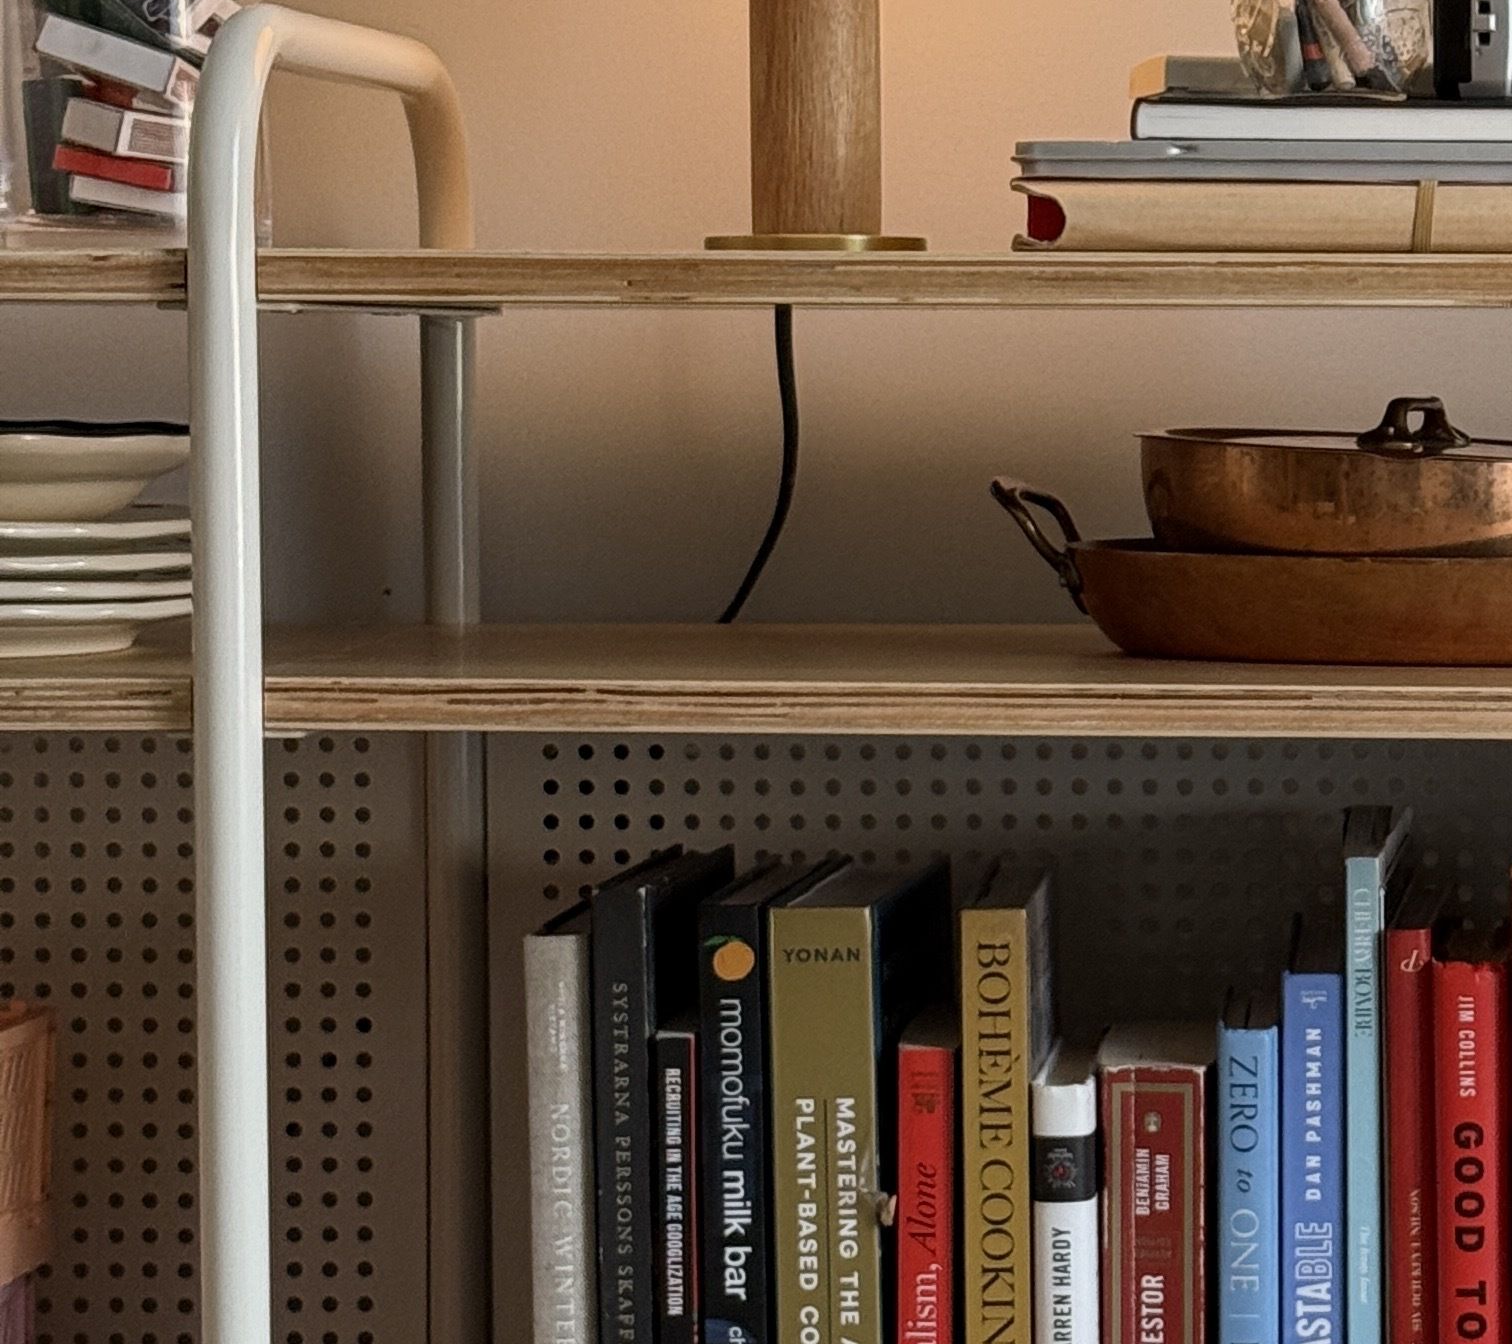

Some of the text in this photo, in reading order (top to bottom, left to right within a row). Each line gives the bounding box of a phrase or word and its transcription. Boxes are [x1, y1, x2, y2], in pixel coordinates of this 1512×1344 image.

[782, 948, 860, 963] YONAN
[1354, 968, 1374, 1037] BOMBE
[612, 983, 629, 1124] SYSTRARNA
[1305, 1028, 1321, 1143] PASHMAN
[1458, 996, 1476, 1098] JIM COLLINS
[550, 1103, 573, 1219] NORDIC
[616, 1136, 633, 1255] PERSSONS
[665, 1068, 683, 1316] RECRUITING IN THE AGE GOOGLIZATION
[720, 998, 752, 1301] momofuku milk bar
[795, 1098, 818, 1291] PLANT-BASED
[835, 1098, 859, 1259] MASTERING
[1136, 1148, 1150, 1215] BENJAMIN
[1155, 1154, 1170, 1212] GRAHAM
[1229, 1056, 1259, 1292] ZERO to ONE
[1305, 1155, 1321, 1201] DAN
[1454, 1121, 1487, 1252] GOOD
[905, 1161, 939, 1254] Alone
[1052, 1226, 1071, 1287] HARDY
[839, 1272, 860, 1325] THE
[1455, 1281, 1488, 1340] TO
